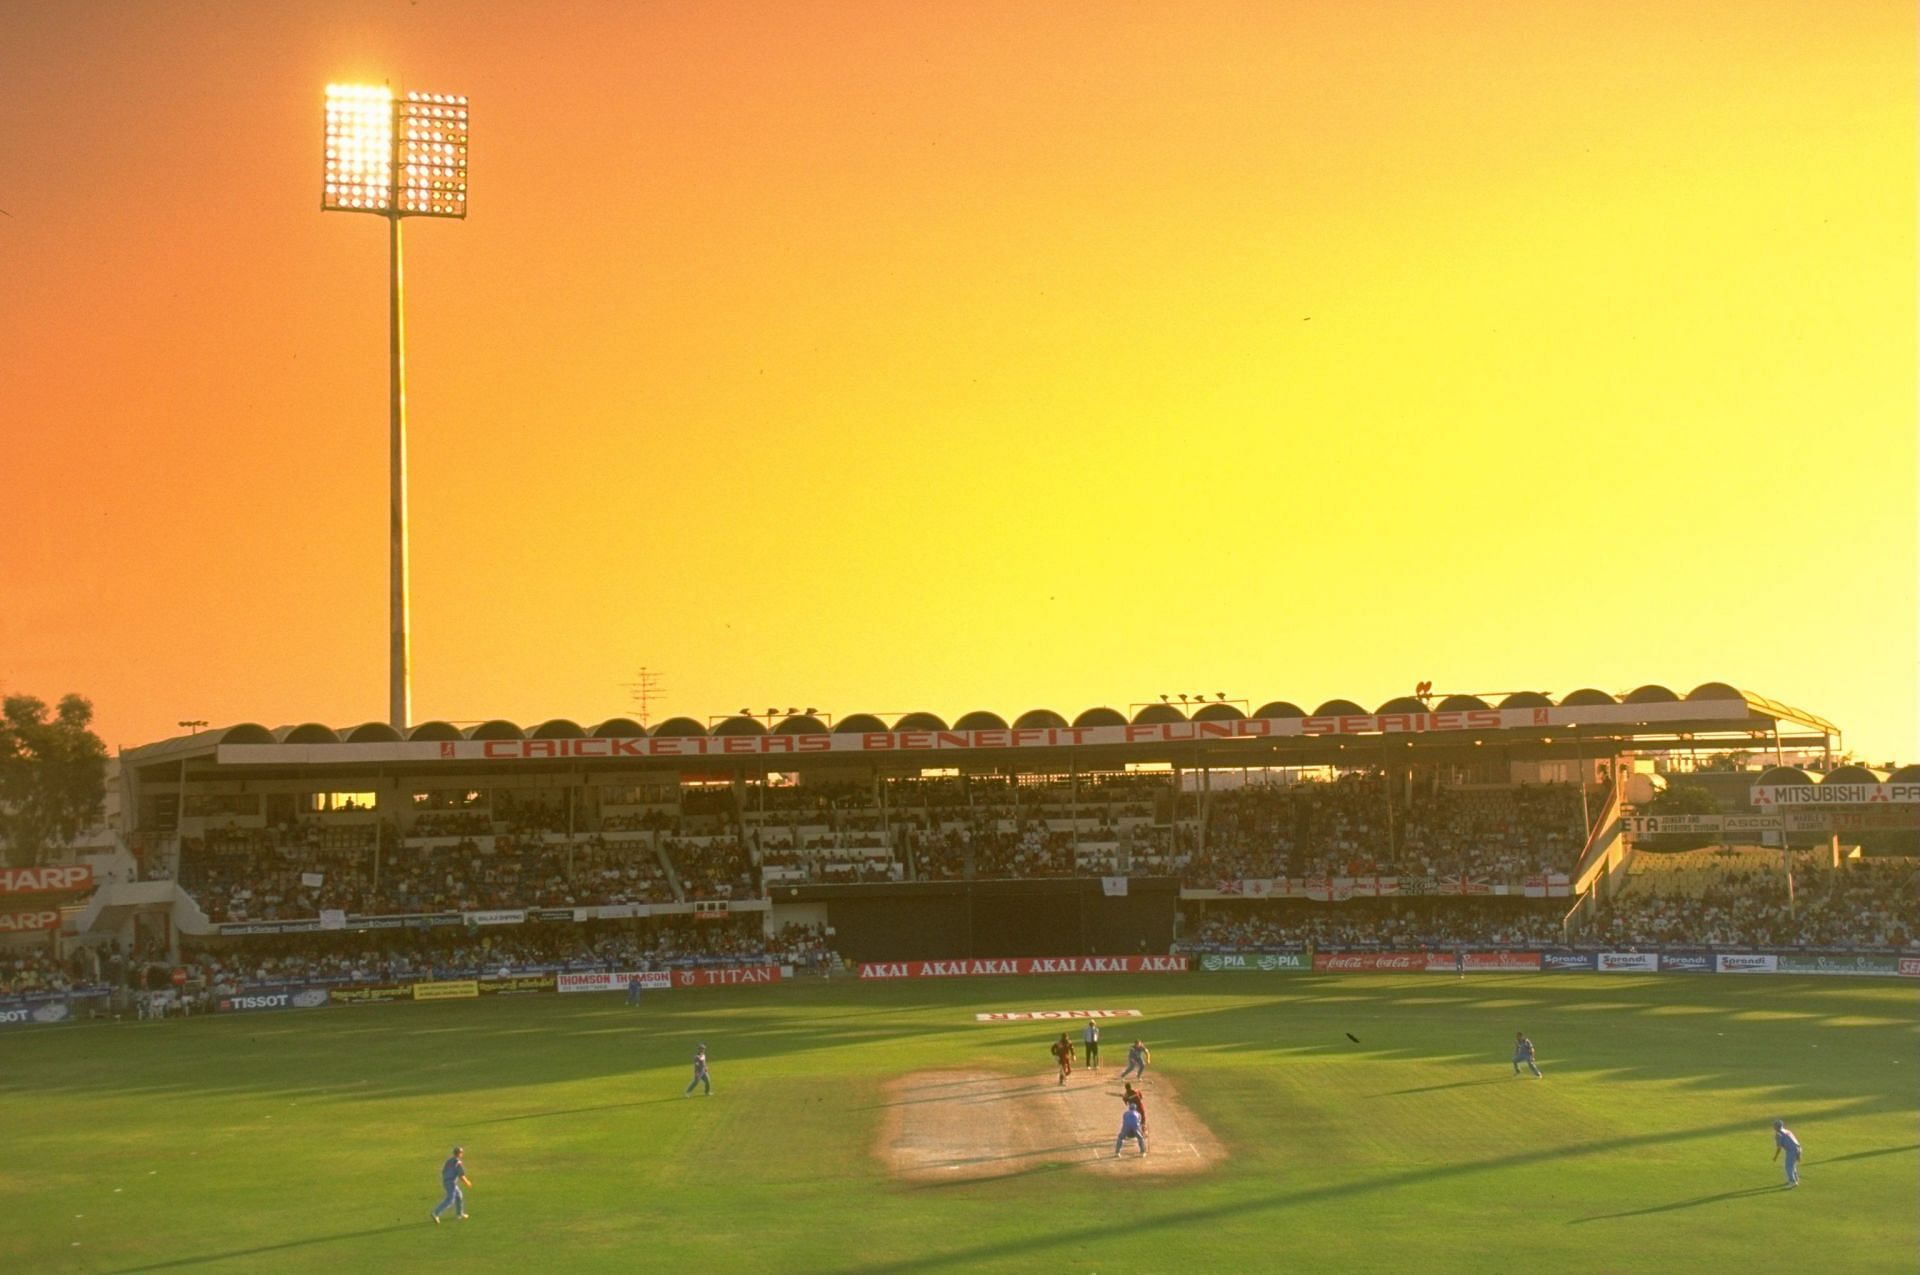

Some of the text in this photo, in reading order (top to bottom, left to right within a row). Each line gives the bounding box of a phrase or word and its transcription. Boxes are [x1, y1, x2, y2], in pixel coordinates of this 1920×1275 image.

[482, 711, 1501, 758] CRICKETERS BENEFIT FUND SERIES
[1774, 785, 1866, 803] MITSUBISHI
[1621, 817, 1659, 832] ETA
[1726, 818, 1782, 828] ASCON
[1223, 956, 1300, 967] PIA PIA
[1545, 954, 1588, 964] Sprandi
[1602, 953, 1647, 964] Sprandi
[1662, 955, 1706, 965] Sprandi
[1722, 956, 1766, 966] Sprandi
[861, 957, 1187, 978] AKAI AKAI AKAI AKAI AKAI AKAI
[560, 975, 611, 985] THOMSON
[704, 968, 772, 985] TITAN
[231, 994, 289, 1009] TISSOT
